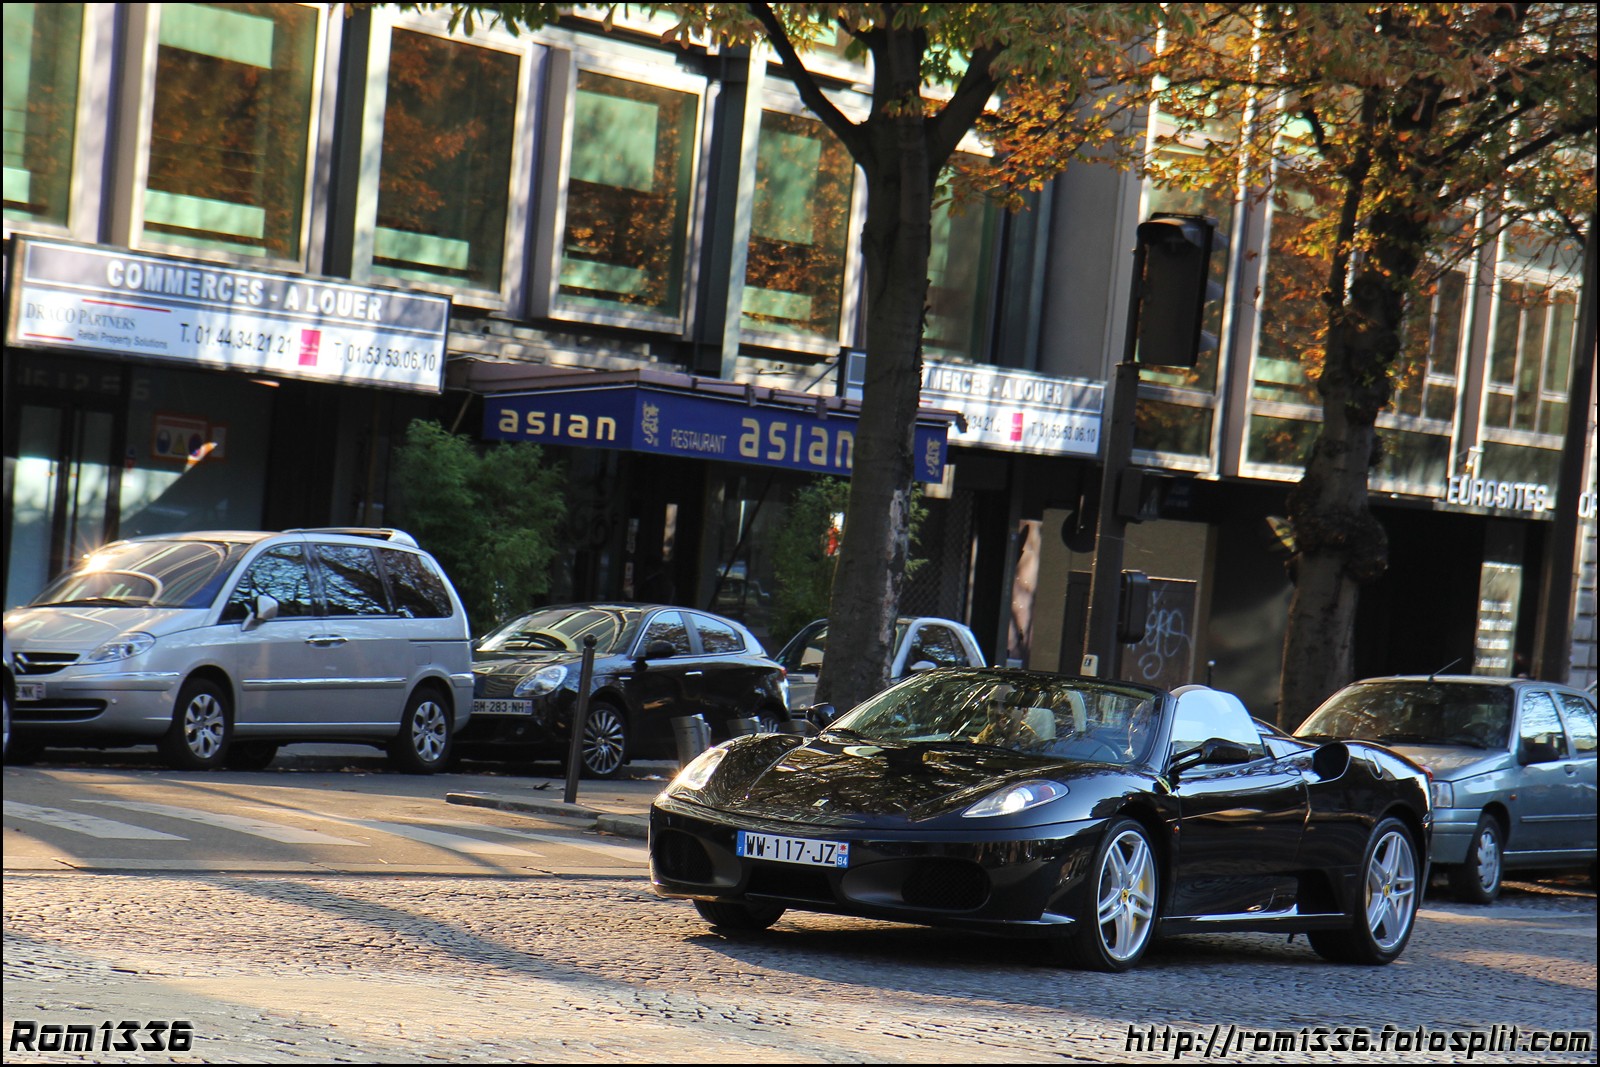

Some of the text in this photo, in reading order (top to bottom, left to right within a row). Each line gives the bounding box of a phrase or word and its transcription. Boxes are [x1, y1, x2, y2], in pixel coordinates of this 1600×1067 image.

[106, 259, 264, 306] COMMERCES
[284, 285, 299, 311] A
[305, 287, 382, 322] LOUER
[78, 309, 136, 331] PARTNERS
[101, 332, 131, 347] Property
[134, 336, 168, 350] Solutions
[180, 322, 190, 343] T.
[195, 325, 291, 355] 01.44.34.21.21
[347, 343, 436, 372] 01.53.53.06.10
[1001, 378, 1012, 399] A
[1014, 379, 1062, 405] LOUER
[498, 408, 616, 441] asian
[671, 428, 727, 454] RESTAURANT
[1448, 475, 1549, 512] EUROSITES
[746, 834, 836, 865] WW-117-JZ
[837, 856, 848, 866] 94
